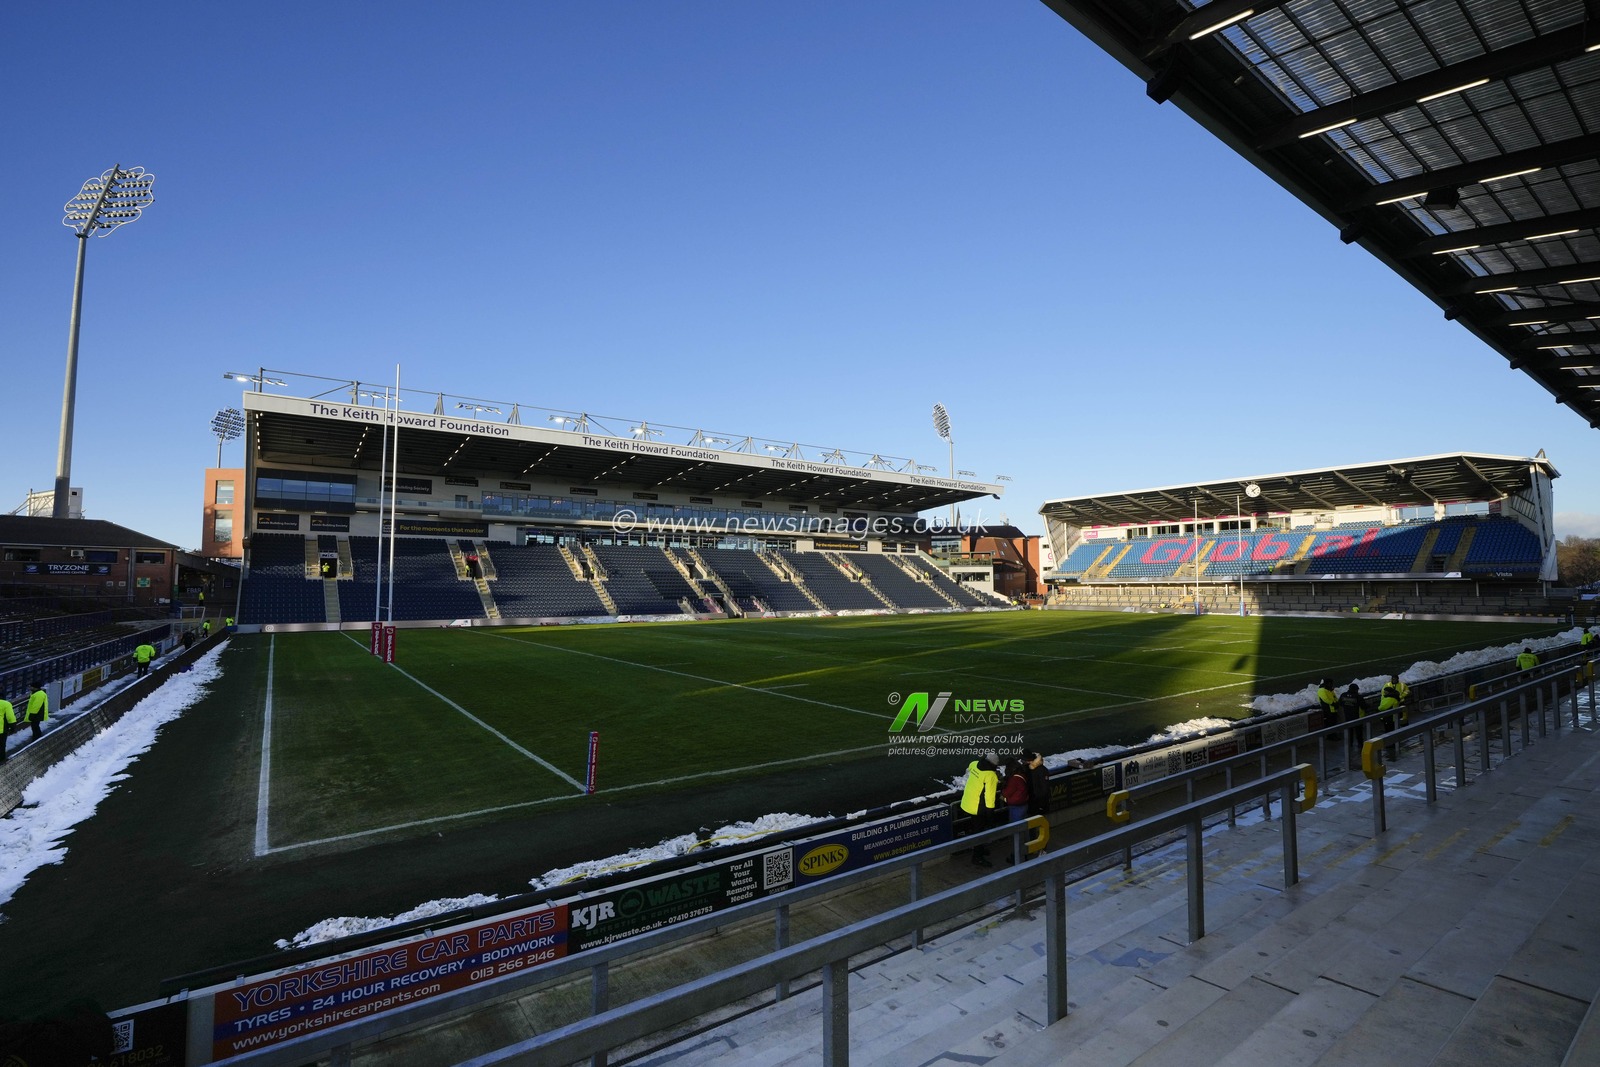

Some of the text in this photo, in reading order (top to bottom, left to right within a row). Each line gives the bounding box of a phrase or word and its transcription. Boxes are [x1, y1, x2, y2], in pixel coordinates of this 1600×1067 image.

[310, 403, 509, 436] The Keith Howard Foundation
[582, 436, 720, 460] The Keith Howard Foundation
[771, 459, 872, 478] The Keith Howard Foundation
[937, 480, 957, 488] Howard
[958, 482, 986, 491] Foundation
[451, 525, 463, 533] that
[1185, 748, 1207, 765] Best
[851, 809, 949, 842] BUILDING & PLUMBING SUPPLIES
[863, 837, 894, 850] MEANWOOD
[730, 860, 753, 872] For All
[803, 849, 845, 871] SPINKS
[731, 876, 753, 888] Waste
[733, 869, 750, 879] Your
[726, 881, 757, 897] Removal
[731, 892, 754, 903] Needs
[571, 871, 720, 930] KJR WASTE
[580, 921, 662, 950] www.kjrwaste.co.uk
[668, 912, 689, 924] 07410
[233, 911, 555, 1012] YORKSHIRE CAR PARTS
[234, 934, 555, 1032] TYRES 24 HOUR RECOVERY BODYWORK
[232, 948, 555, 1050] www.yorkshirecarparts.com 0113 266 2146
